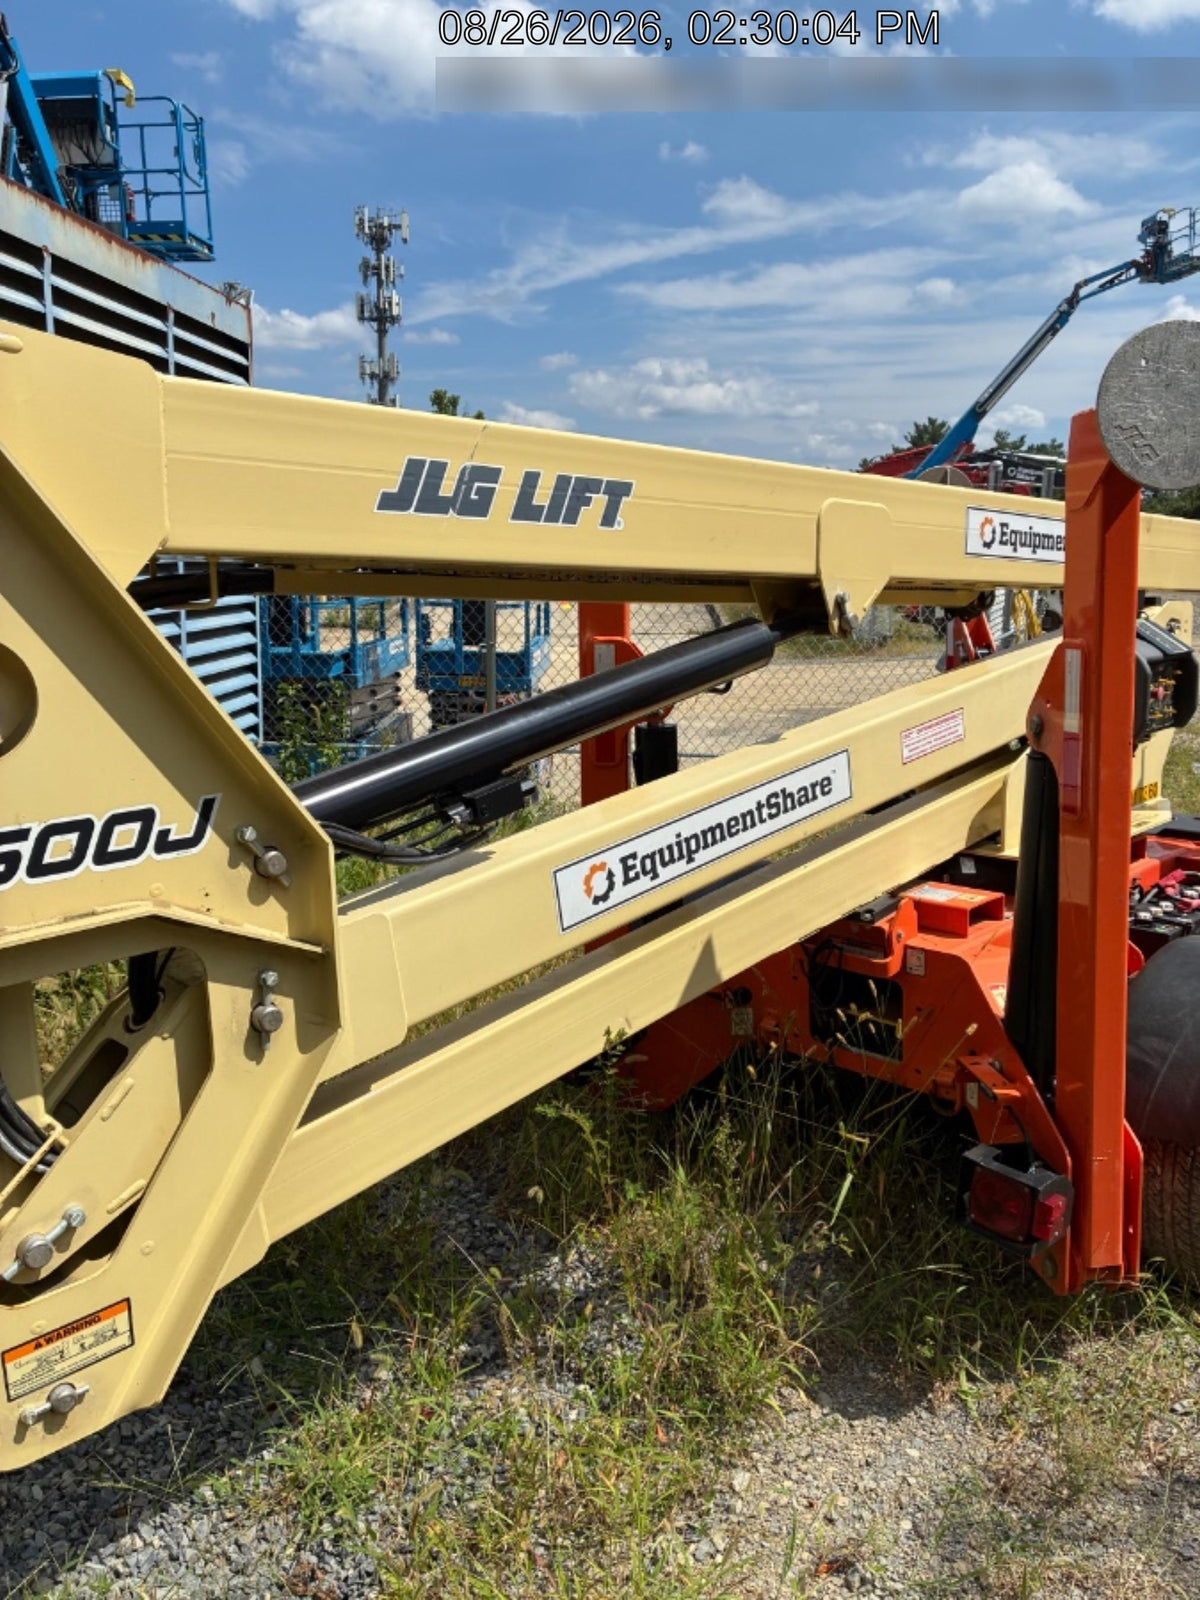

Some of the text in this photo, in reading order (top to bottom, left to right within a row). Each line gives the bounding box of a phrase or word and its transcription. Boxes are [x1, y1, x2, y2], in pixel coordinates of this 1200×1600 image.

[375, 456, 635, 529] JLG LIFT
[619, 775, 833, 886] EquipmentShare
